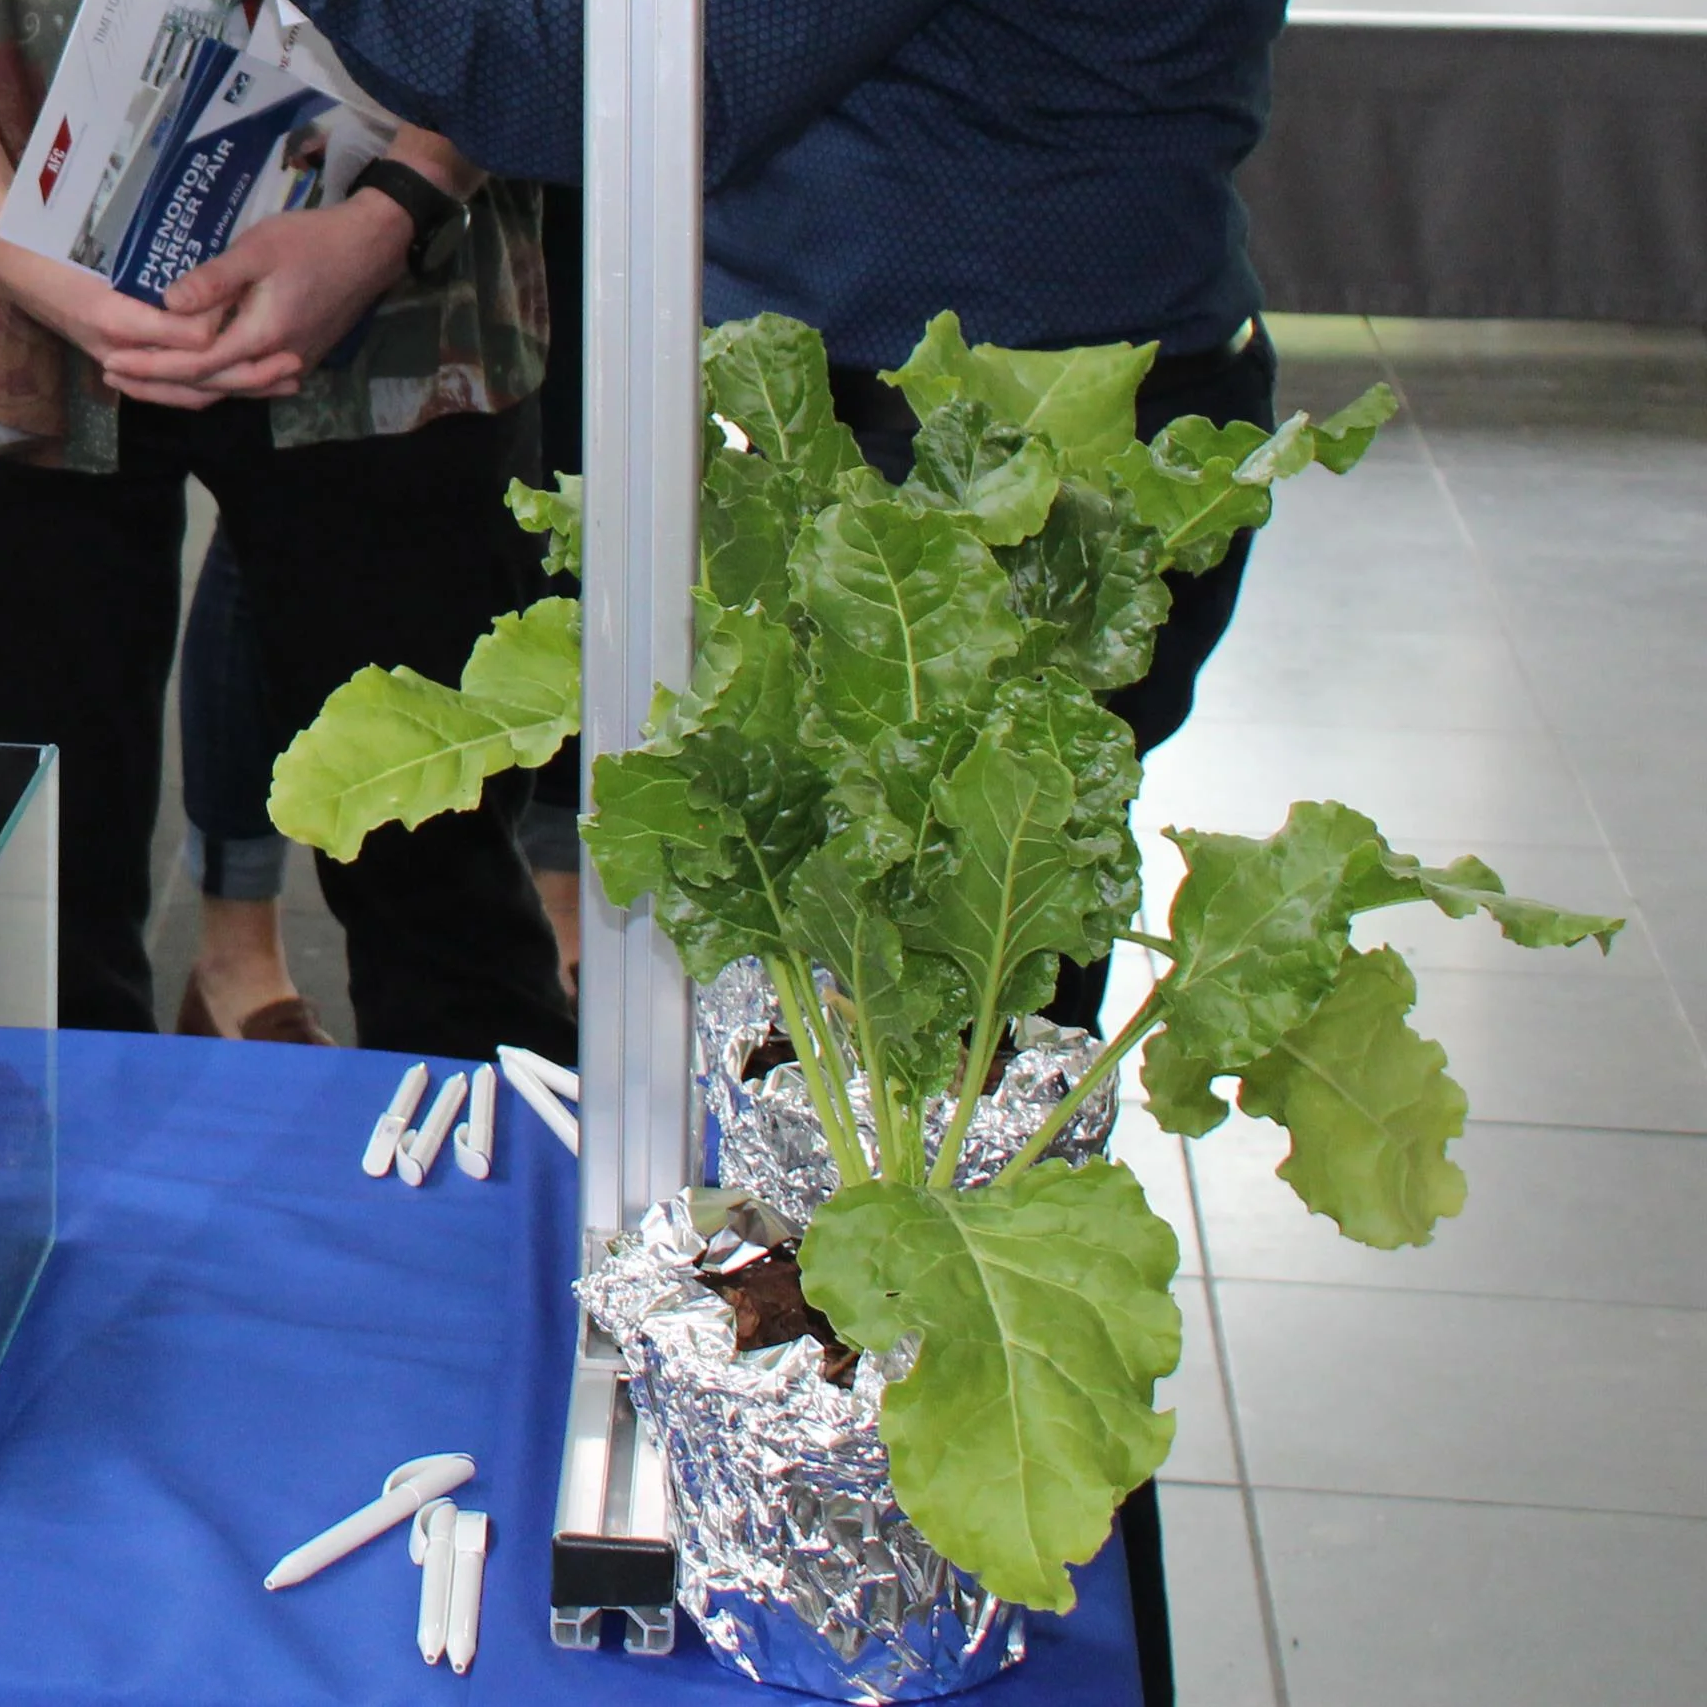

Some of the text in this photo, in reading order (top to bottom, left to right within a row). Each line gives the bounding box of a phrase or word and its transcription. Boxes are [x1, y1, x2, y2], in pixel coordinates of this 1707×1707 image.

[92, 15, 112, 45] TIME
[47, 147, 66, 174] AFC
[137, 152, 209, 288] PHENOROB
[153, 138, 236, 294] CAREER FAIR
[214, 206, 234, 237] May
[228, 172, 253, 207] 2023
[176, 238, 203, 280] 23
